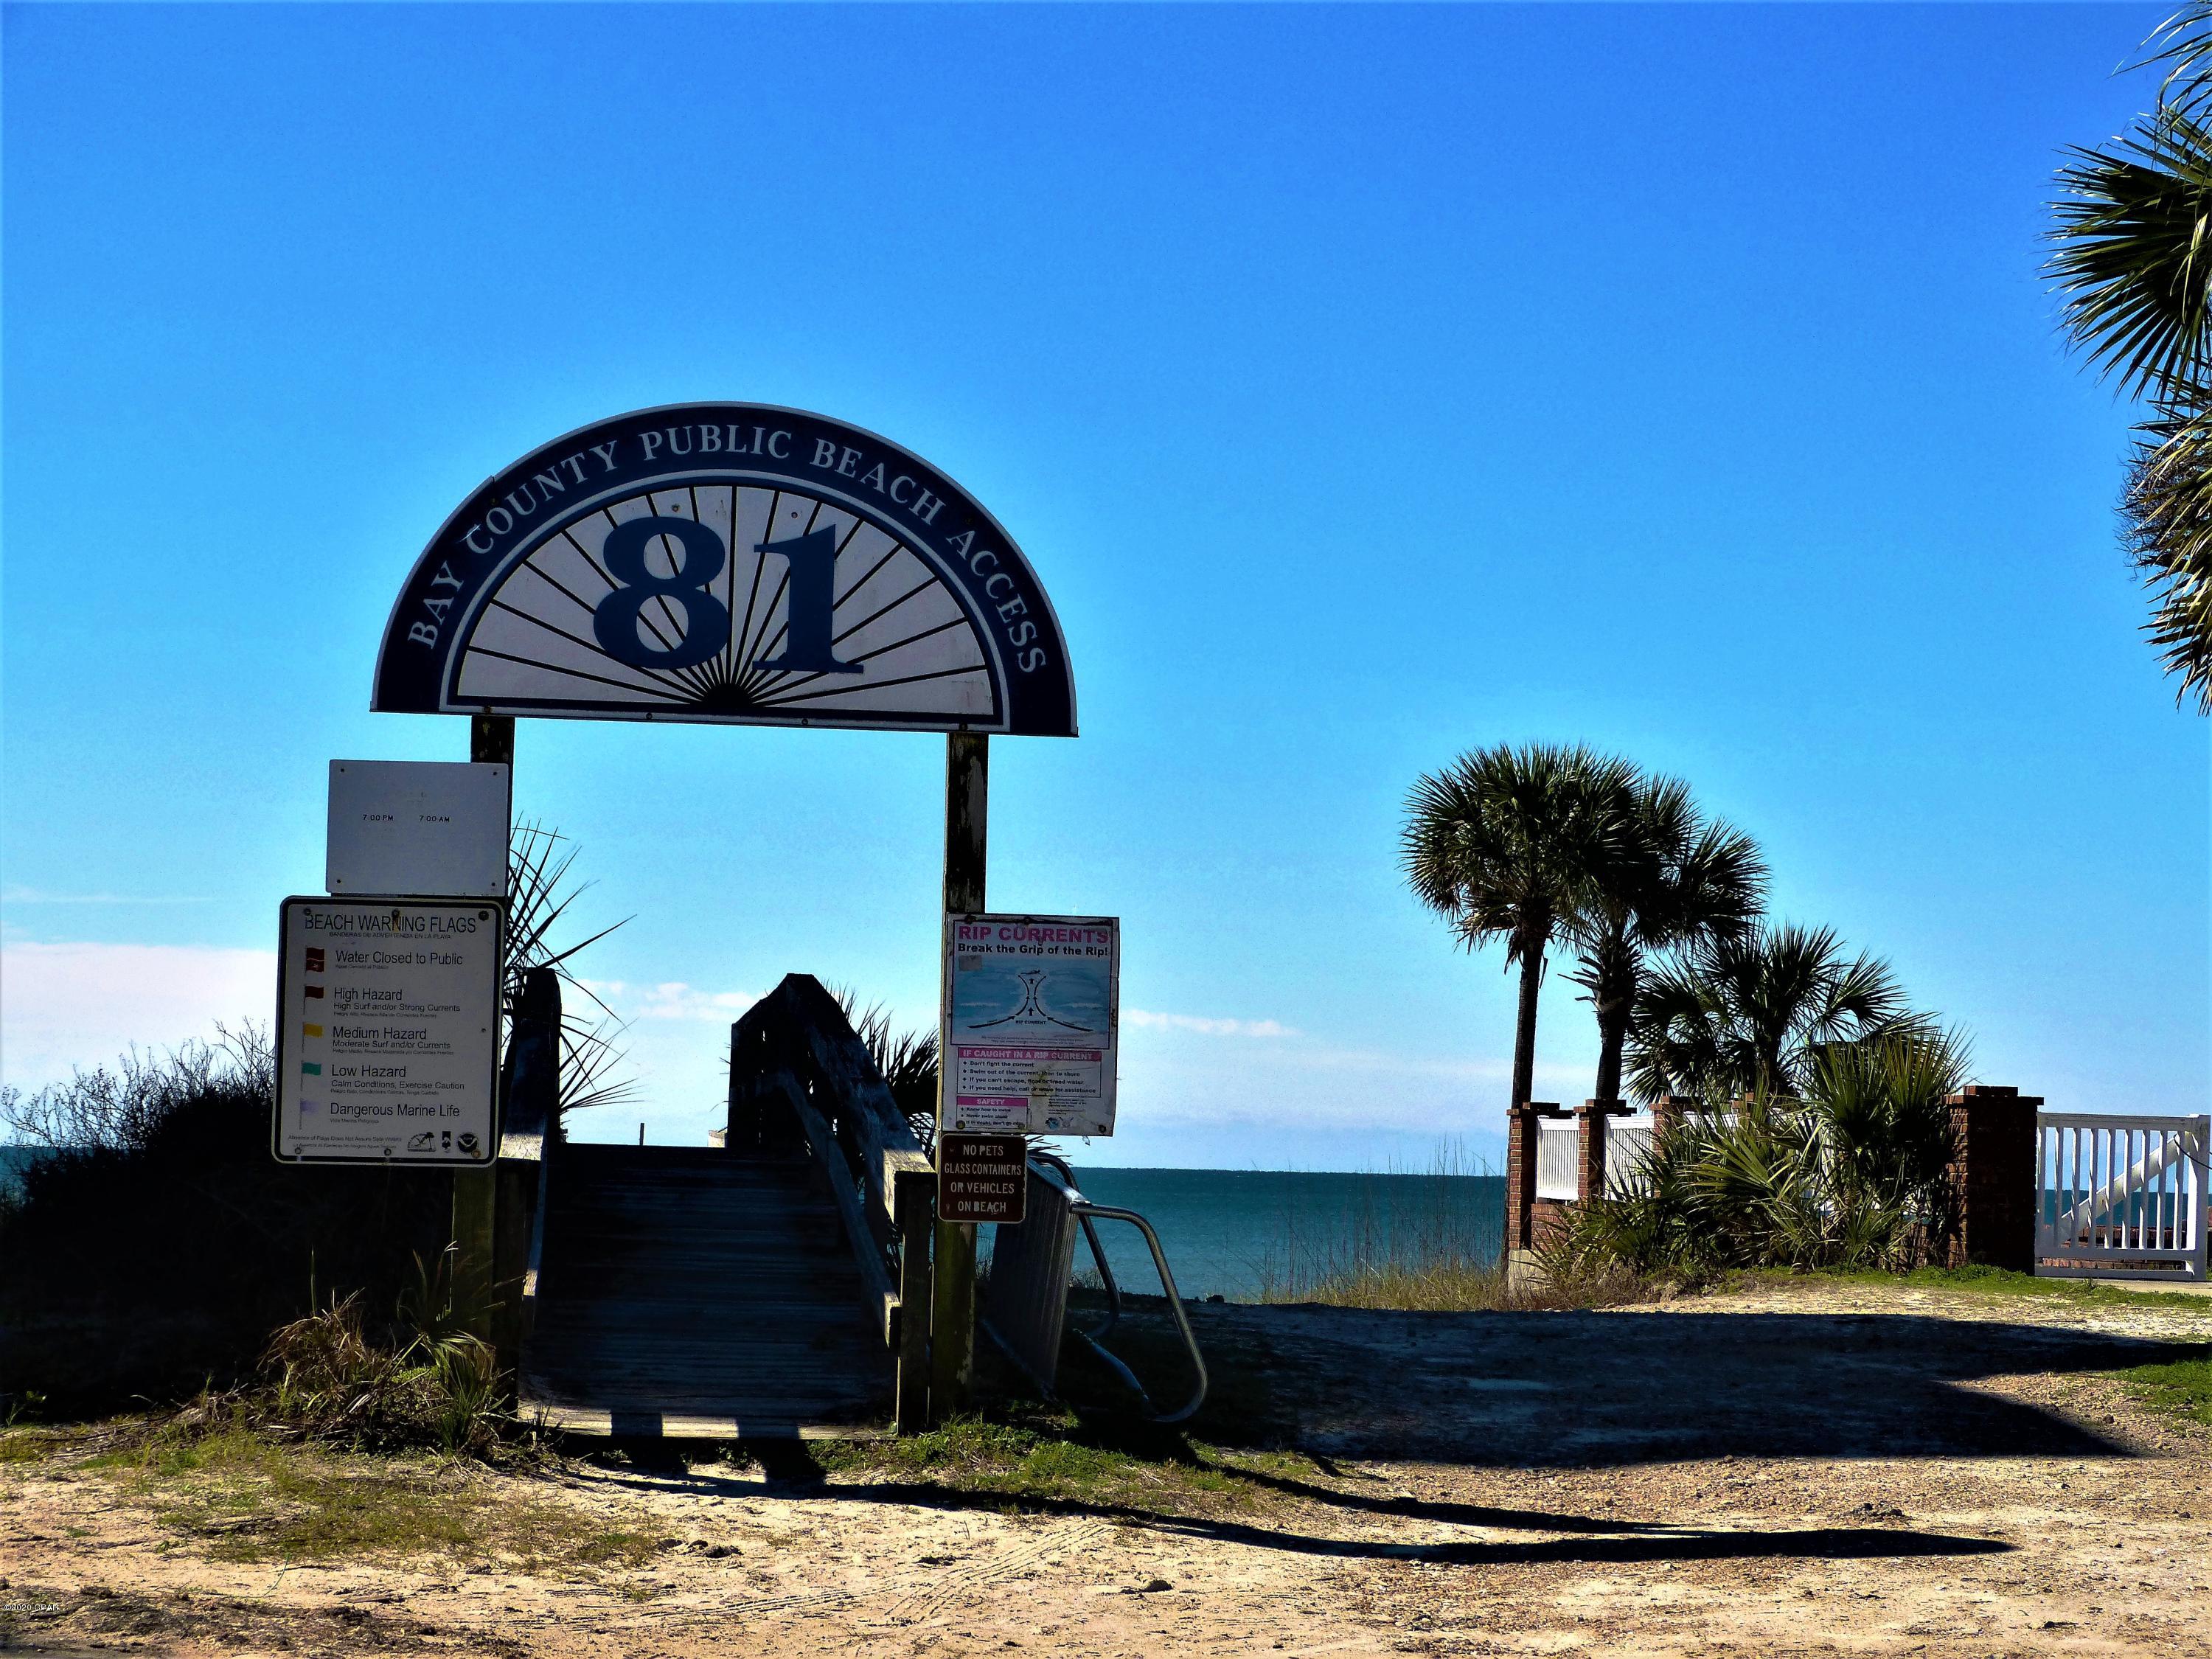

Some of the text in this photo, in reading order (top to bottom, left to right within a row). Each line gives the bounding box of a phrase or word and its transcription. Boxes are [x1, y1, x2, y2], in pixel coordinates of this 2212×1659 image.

[407, 425, 1046, 673] BAY COUNTY PUBLIC BEACH ACCESS
[594, 515, 865, 674] 81
[305, 914, 476, 933] BEACH WARNING FLAGS
[959, 925, 1108, 944] RIP CURRENTS
[958, 943, 1109, 957] Break the Grip of the Rip!
[335, 950, 464, 965] Water Closed to Public
[334, 987, 403, 1002] High Hazard
[334, 1002, 351, 1011] High
[372, 1003, 396, 1011] and/or
[399, 1004, 425, 1012] Strong
[333, 1026, 427, 1040] Medium Hazard
[333, 1040, 369, 1048] Moderate
[974, 1050, 1011, 1058] CAUGHT
[332, 1065, 407, 1077] Low Hazard
[354, 1080, 397, 1089] Conditions,
[436, 1082, 465, 1090] Caution
[330, 1103, 460, 1118] Dangerous Marine Life
[963, 1144, 1004, 1156] NO PETS
[945, 1163, 1022, 1176] GLASS CONTAINERS
[950, 1182, 1015, 1194] OR VEHICLES
[958, 1200, 1006, 1213] ON BEACH
